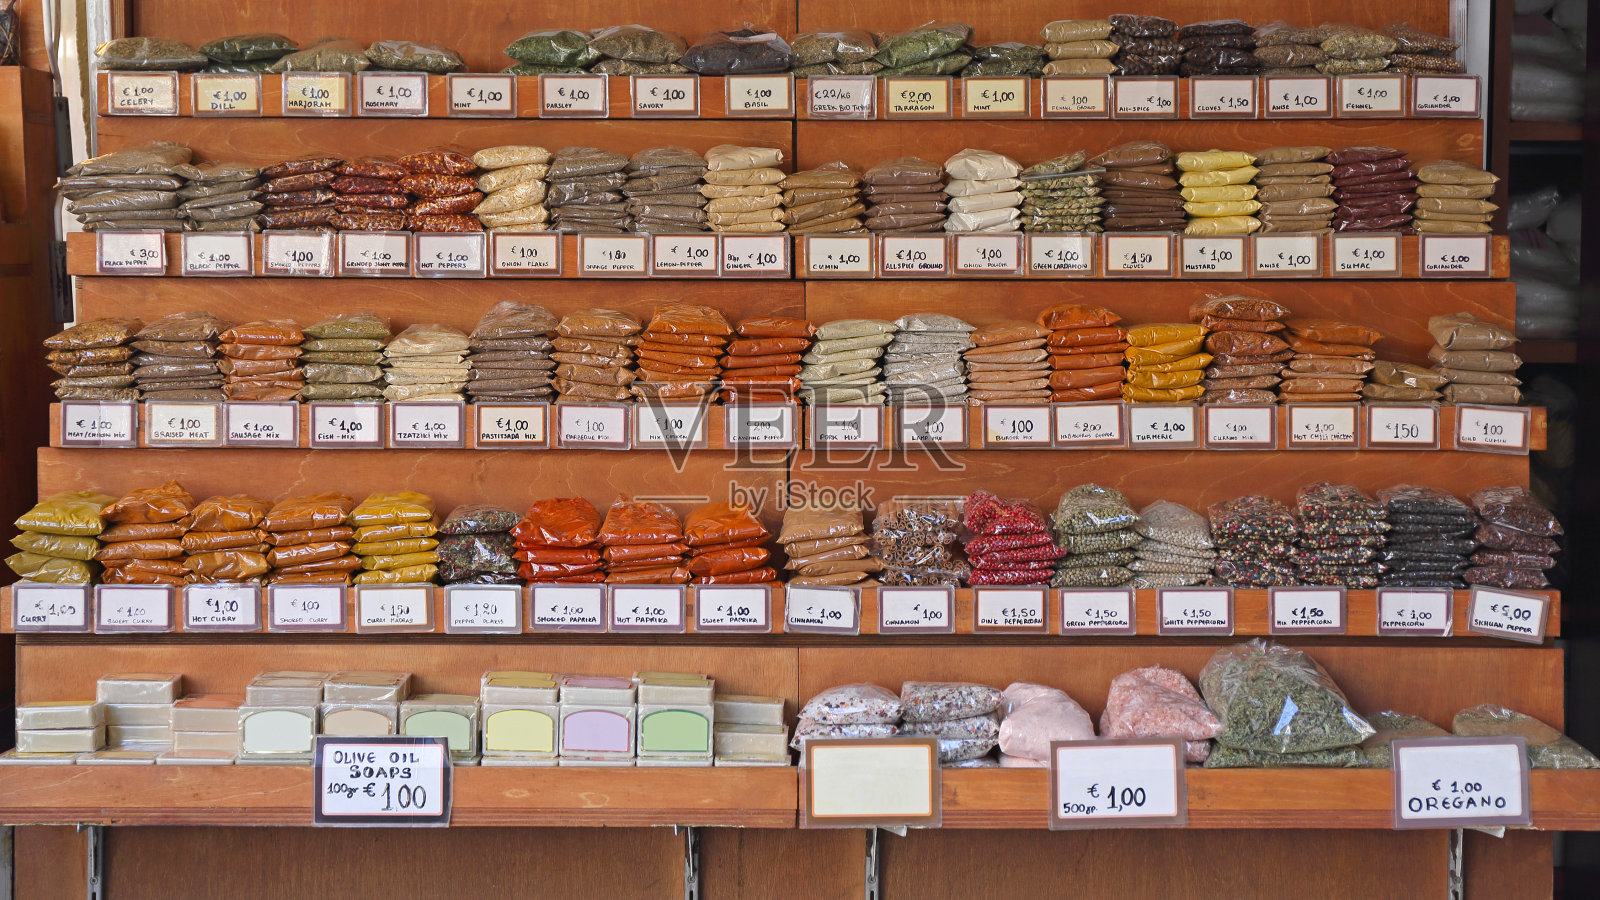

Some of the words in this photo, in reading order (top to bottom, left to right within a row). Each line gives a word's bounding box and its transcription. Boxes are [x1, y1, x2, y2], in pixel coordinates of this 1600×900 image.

[211, 102, 236, 110] DILL
[333, 751, 376, 764] OLIVE
[389, 752, 419, 763] OIL
[350, 765, 412, 779] SOAPS
[327, 782, 359, 799] 100gr
[363, 782, 376, 797] €
[1432, 779, 1441, 791] €
[1451, 781, 1483, 794] 1,00
[1087, 784, 1099, 798] €
[1107, 786, 1146, 812] 1,00
[1409, 796, 1506, 812] OREGANO
